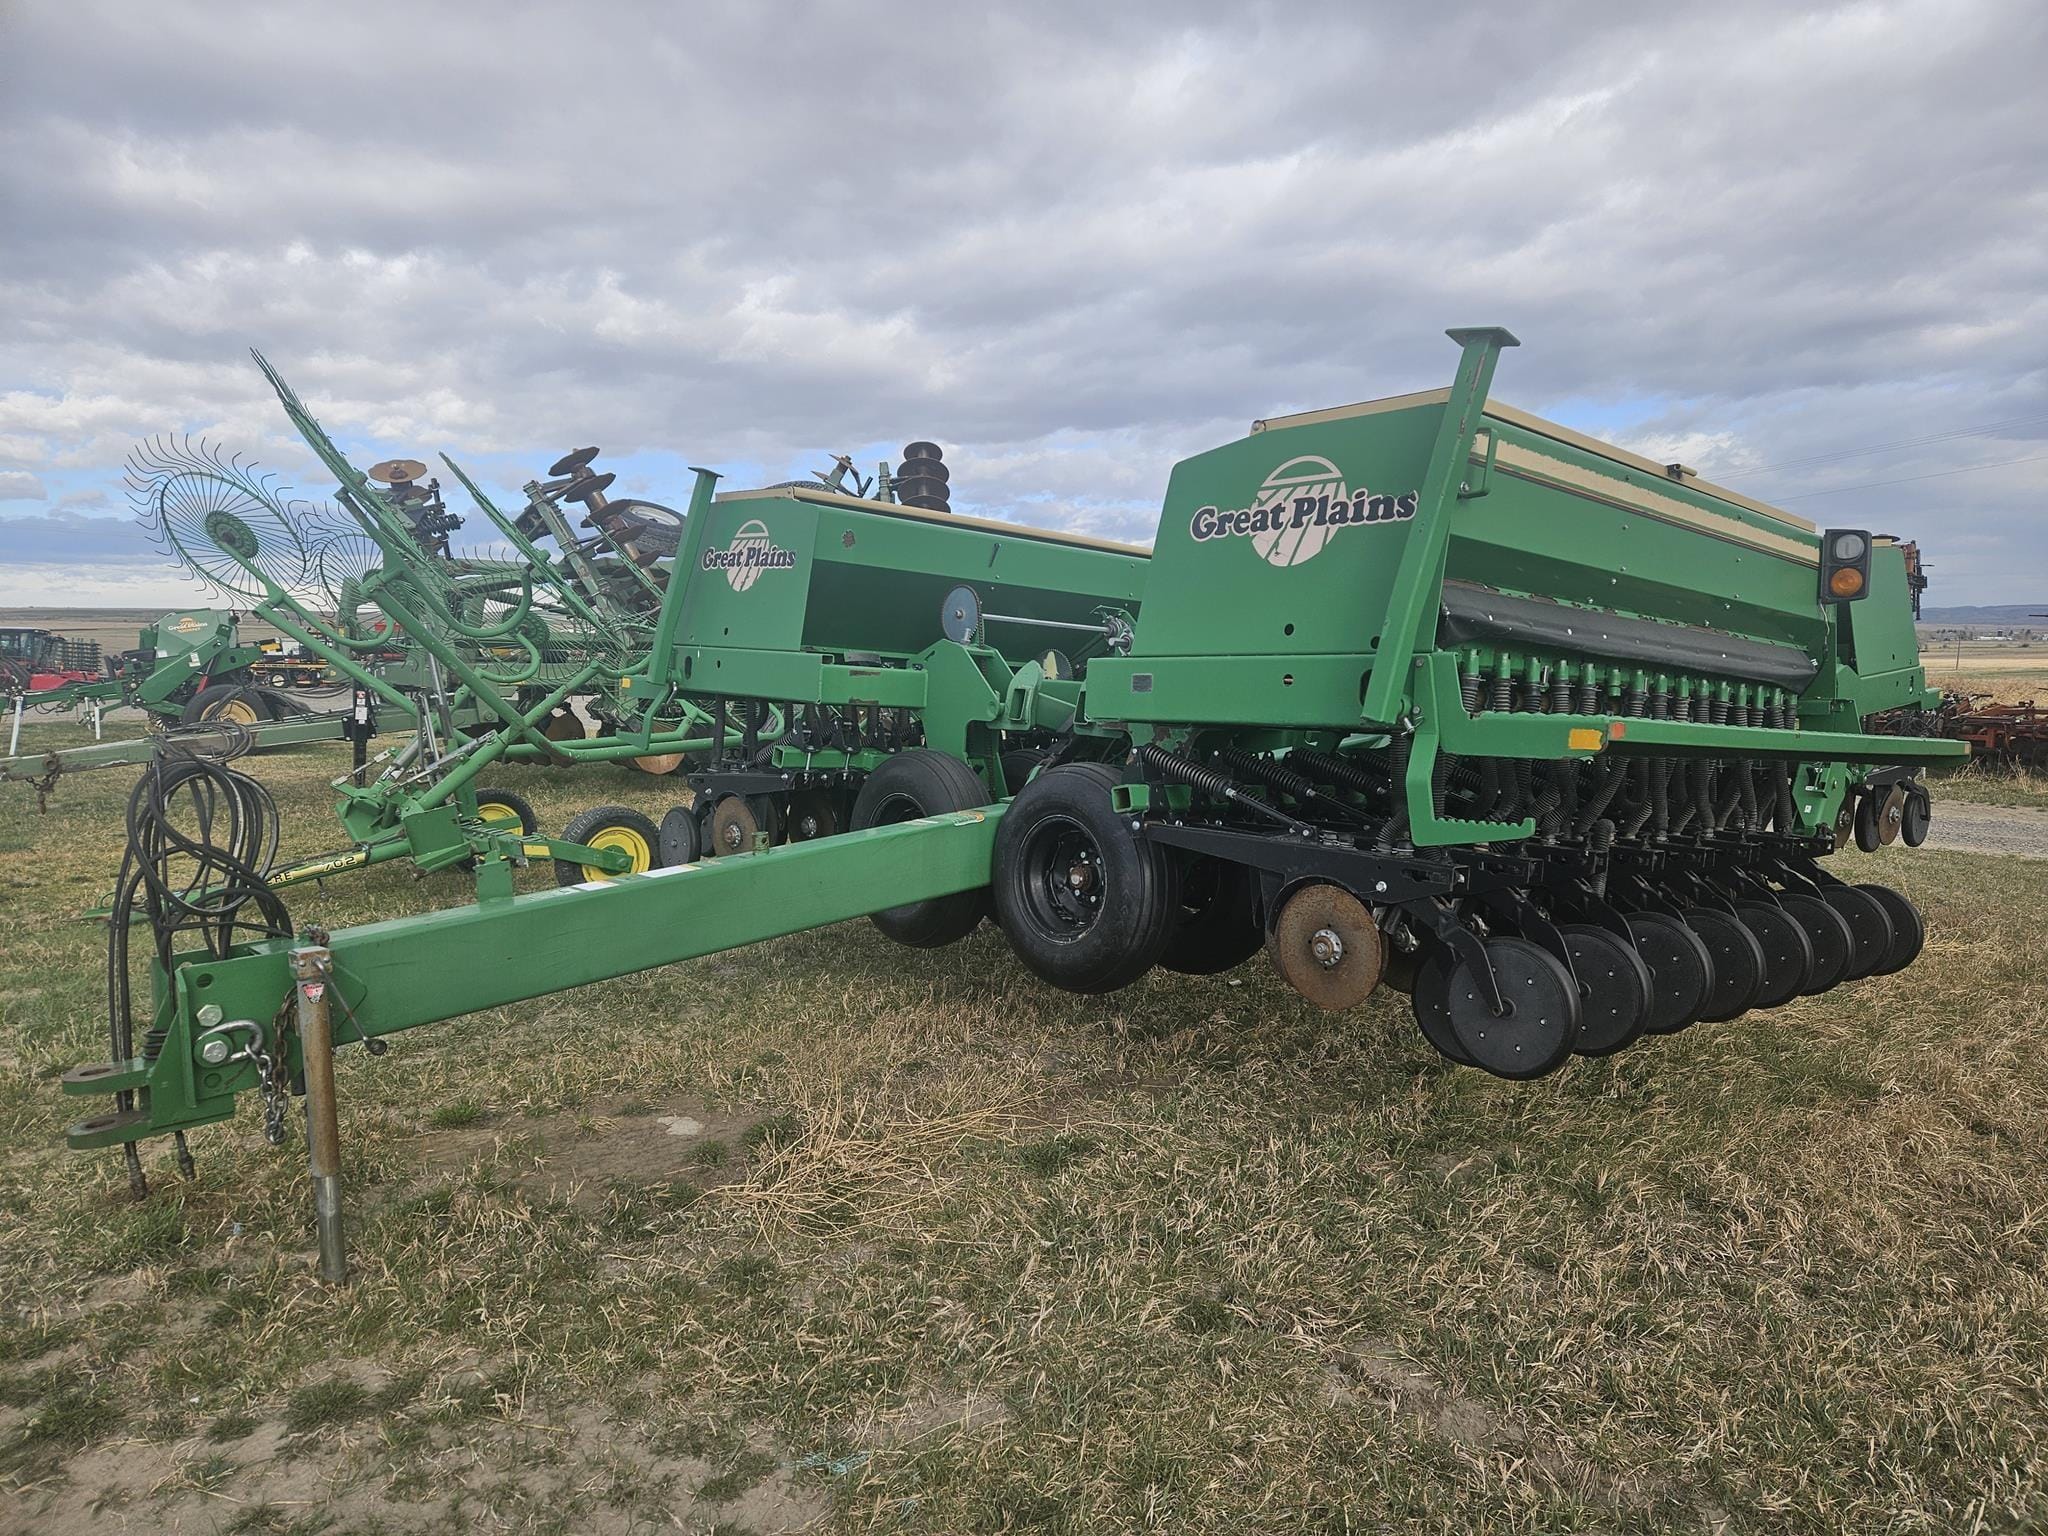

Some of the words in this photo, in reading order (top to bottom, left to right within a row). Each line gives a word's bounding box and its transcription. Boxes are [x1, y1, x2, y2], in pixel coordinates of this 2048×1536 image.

[1190, 498, 1287, 542] Great
[1289, 488, 1418, 530] Plains
[702, 547, 743, 570] Great
[743, 545, 796, 569] Plains
